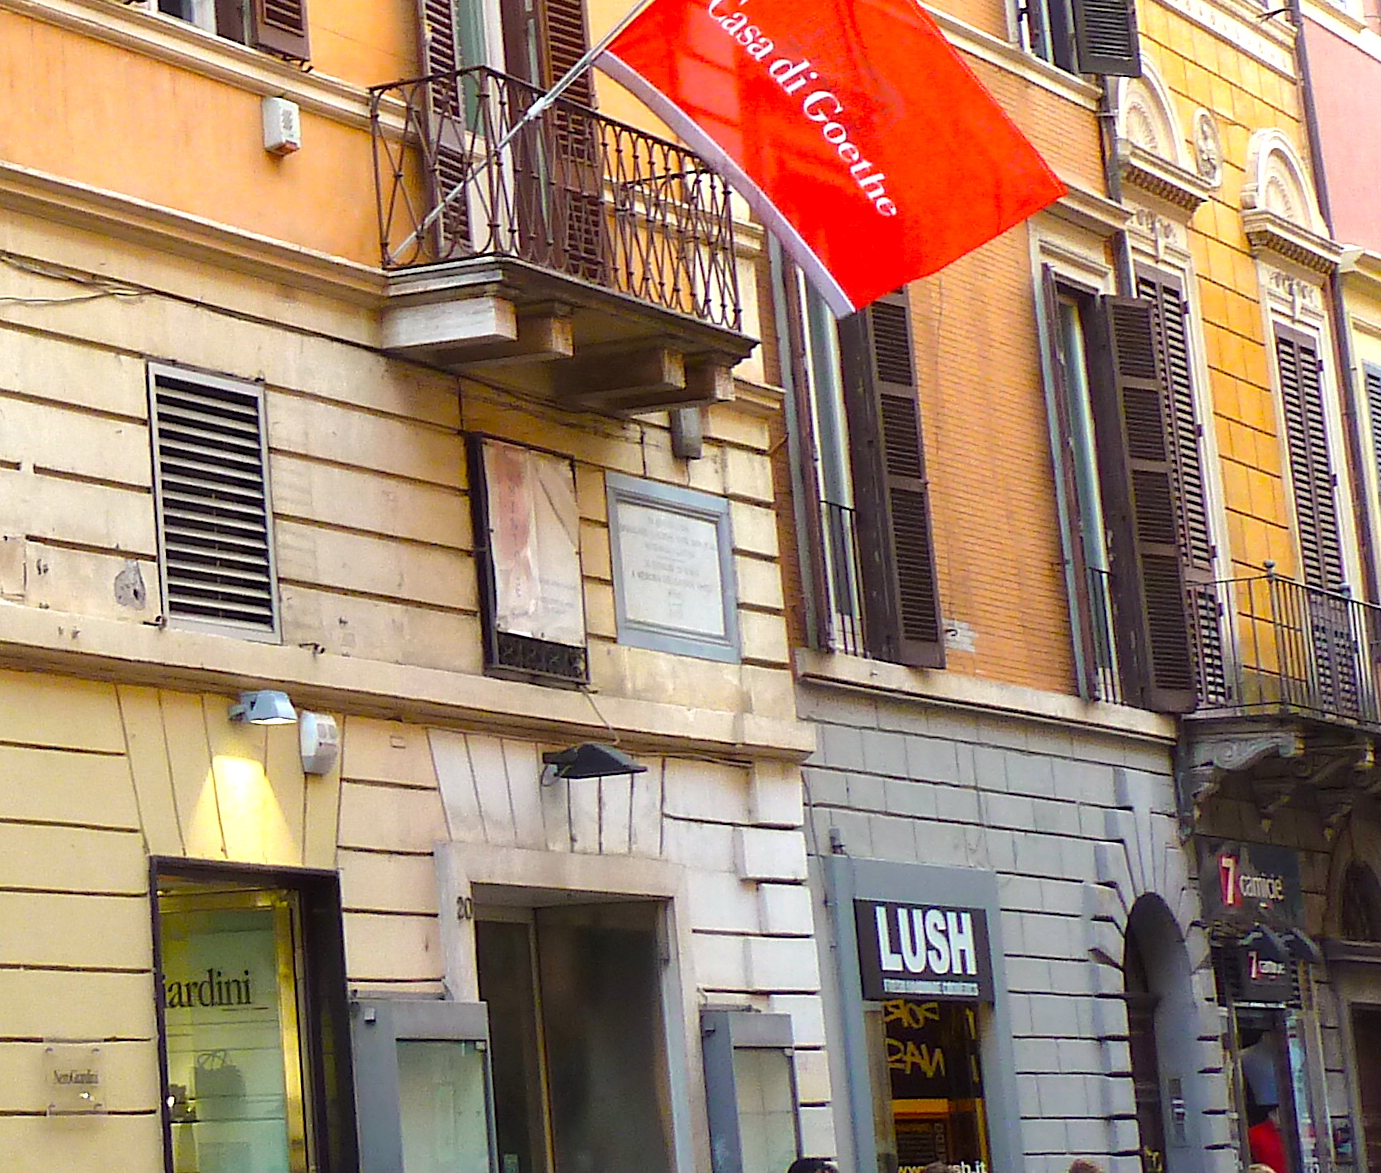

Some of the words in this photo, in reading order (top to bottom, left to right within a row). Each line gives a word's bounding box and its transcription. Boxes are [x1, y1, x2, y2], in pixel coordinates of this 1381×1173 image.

[769, 57, 817, 96] di
[802, 89, 898, 218] Goethe
[456, 896, 473, 920] 20
[875, 906, 977, 974] LUSH
